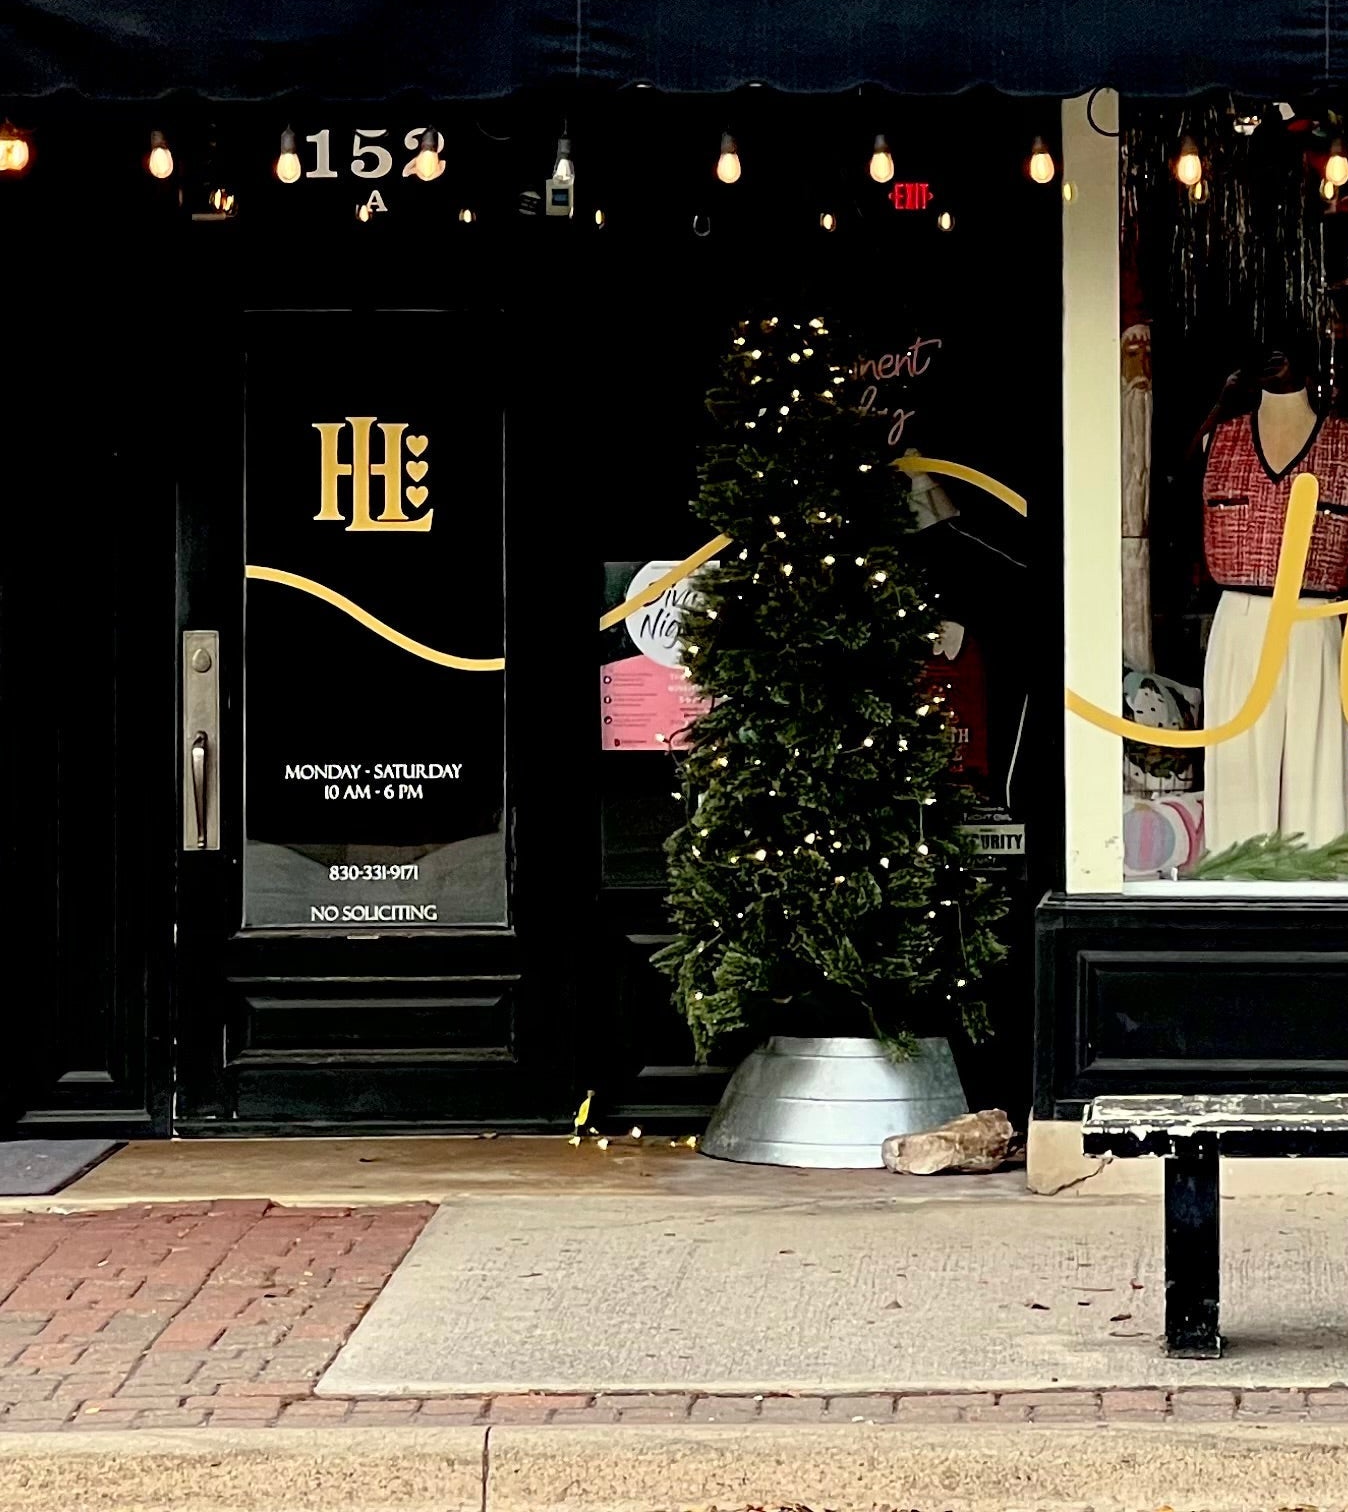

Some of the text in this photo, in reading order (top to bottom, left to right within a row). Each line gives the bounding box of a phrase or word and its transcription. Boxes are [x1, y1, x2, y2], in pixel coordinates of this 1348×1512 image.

[305, 128, 447, 180] 152
[367, 189, 389, 212] A
[894, 183, 930, 210] EXIT
[639, 607, 682, 649] Nig
[284, 763, 362, 780] MONDAY
[373, 763, 463, 780] SATURDAY
[324, 784, 340, 800] 10
[343, 784, 372, 800] AM
[383, 784, 395, 800] 6
[398, 784, 424, 800] PM
[971, 833, 1023, 850] URITY
[328, 864, 419, 881] 830-331-9171
[310, 904, 438, 922] NO SOLICITING
